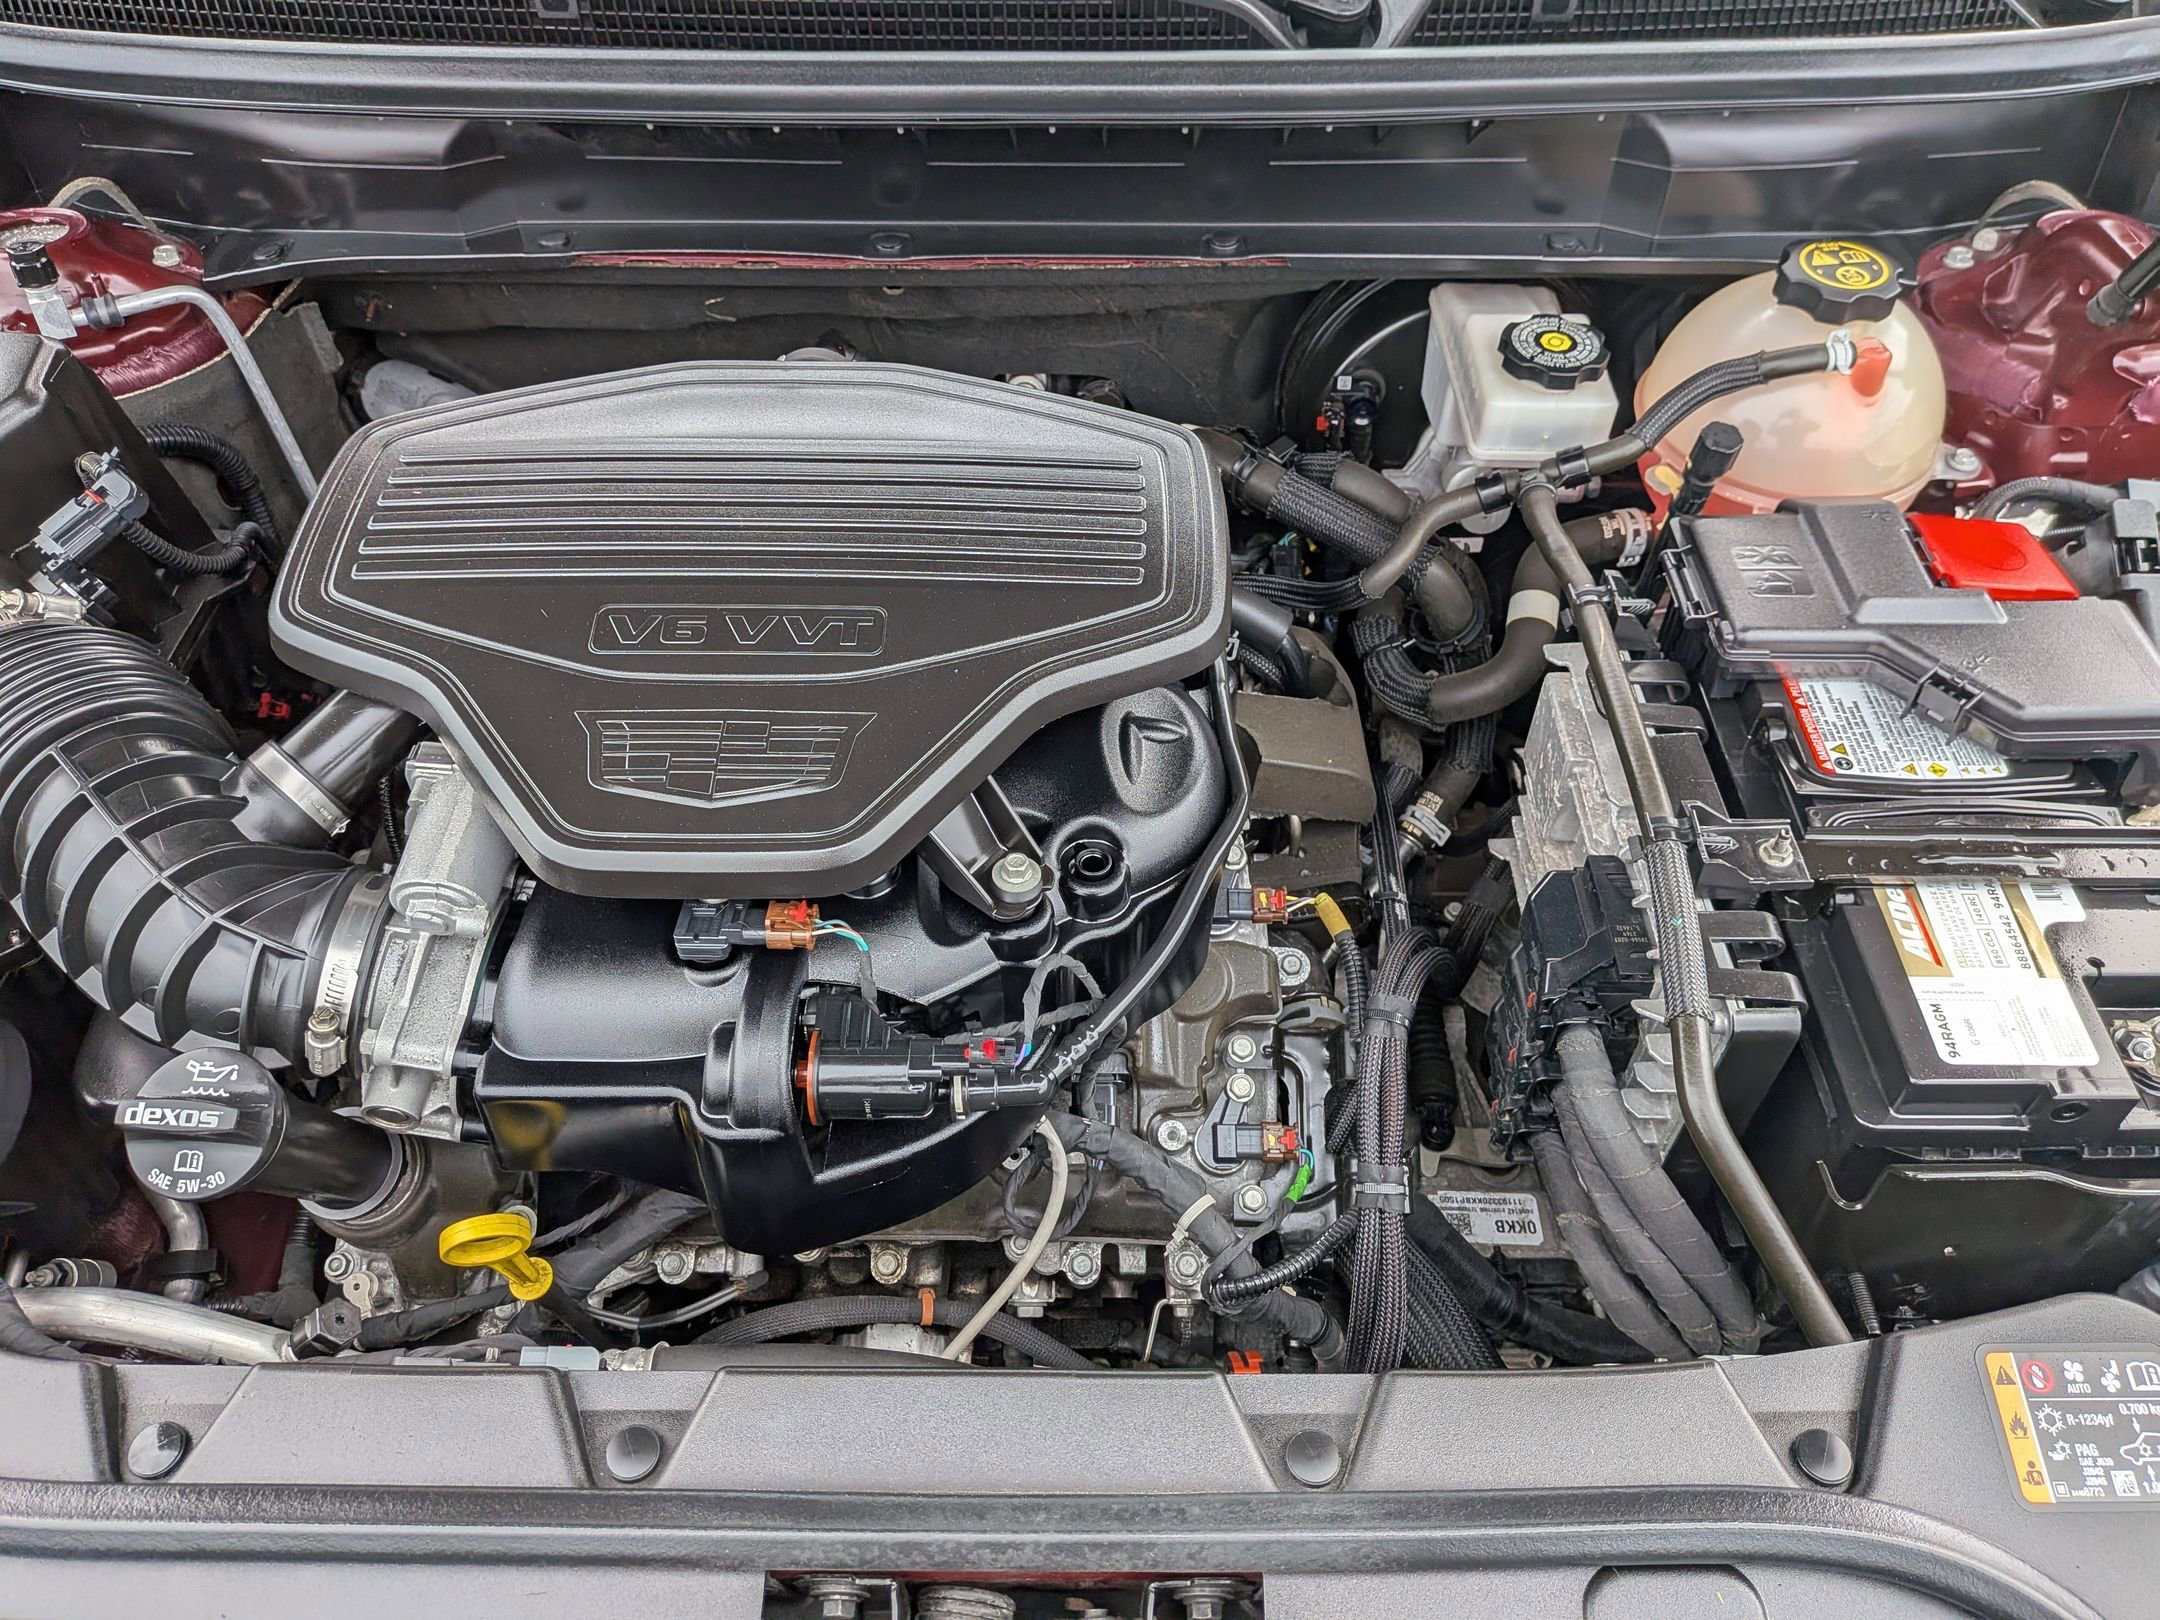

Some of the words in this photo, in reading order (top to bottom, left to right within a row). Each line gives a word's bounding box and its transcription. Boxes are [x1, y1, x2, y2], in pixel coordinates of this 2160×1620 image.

[608, 615, 707, 644] V6
[725, 615, 874, 646] VVT
[1799, 708, 1819, 734] POISON
[1809, 733, 1830, 760] DANGER
[1967, 896, 1978, 906] RC
[1972, 908, 1984, 921] 140
[1983, 931, 1996, 947] CCA
[1999, 915, 2032, 969] 88864542
[1991, 949, 2003, 964] 850
[1929, 1003, 1961, 1058] 94RAGM
[124, 1101, 220, 1128] dexos
[147, 1168, 173, 1190] SAE
[176, 1171, 226, 1194] 5W-30
[2067, 1383, 2092, 1394] AUTO
[2118, 1402, 2149, 1415] 0.700
[2065, 1413, 2115, 1428] R-1234yf
[2074, 1443, 2099, 1457] PAG
[2079, 1457, 2095, 1466] SAE
